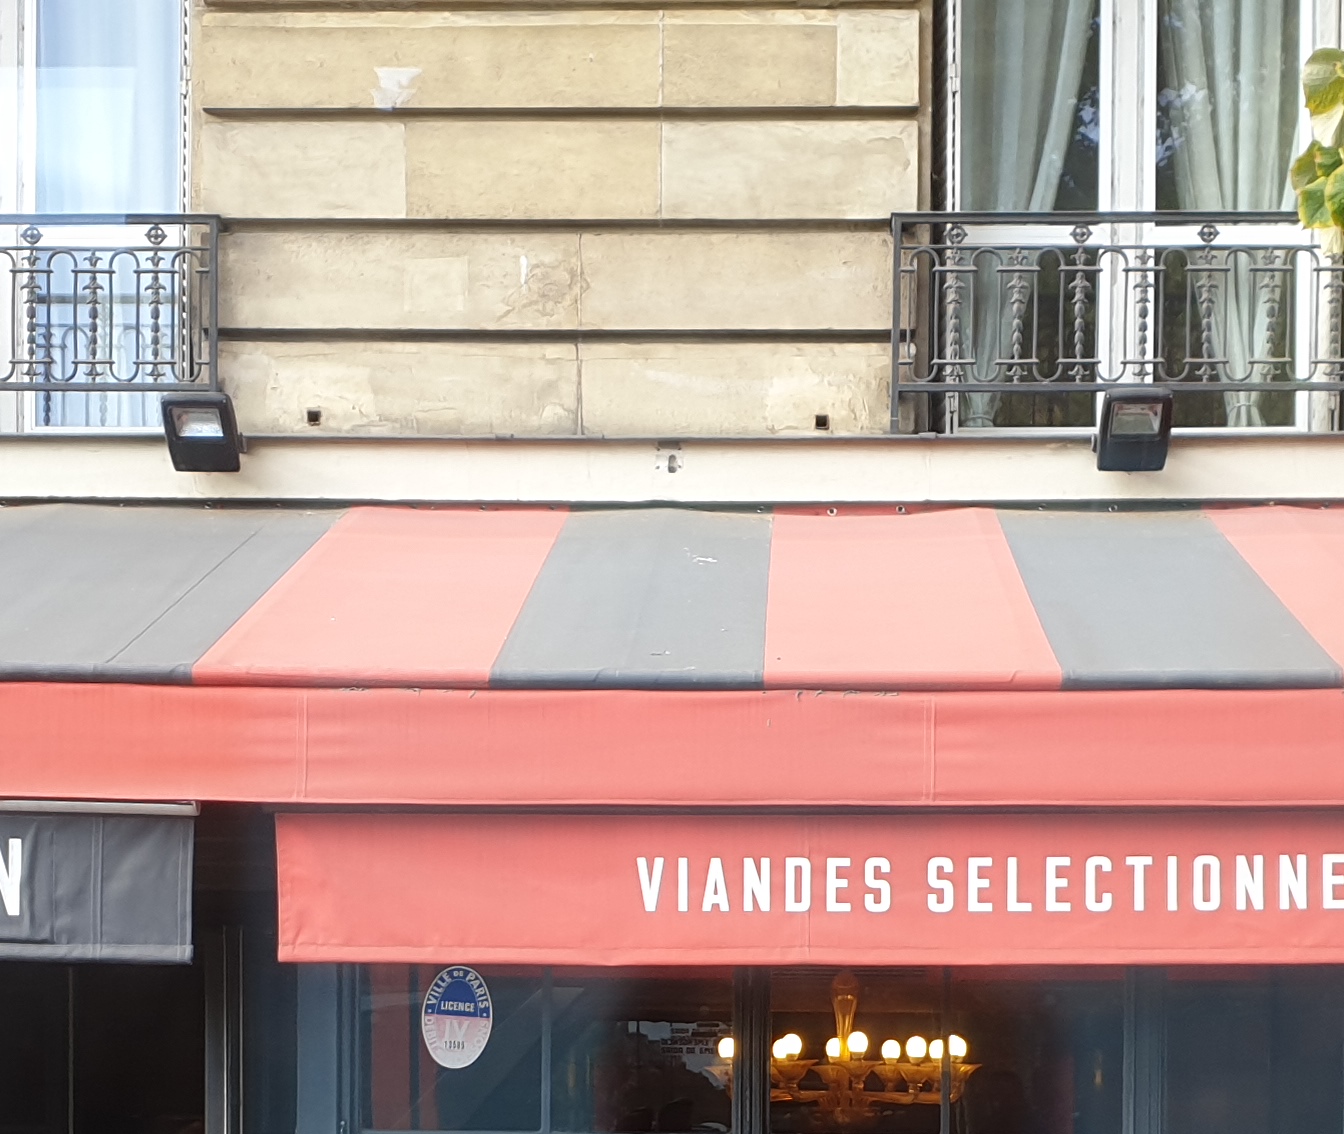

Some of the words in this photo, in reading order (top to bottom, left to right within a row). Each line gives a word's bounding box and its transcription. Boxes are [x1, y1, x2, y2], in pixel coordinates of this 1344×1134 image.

[636, 856, 892, 913] VIANDES
[426, 972, 452, 1004] VILLE
[465, 972, 489, 1009] PARIS
[440, 1000, 475, 1012] LICENCE
